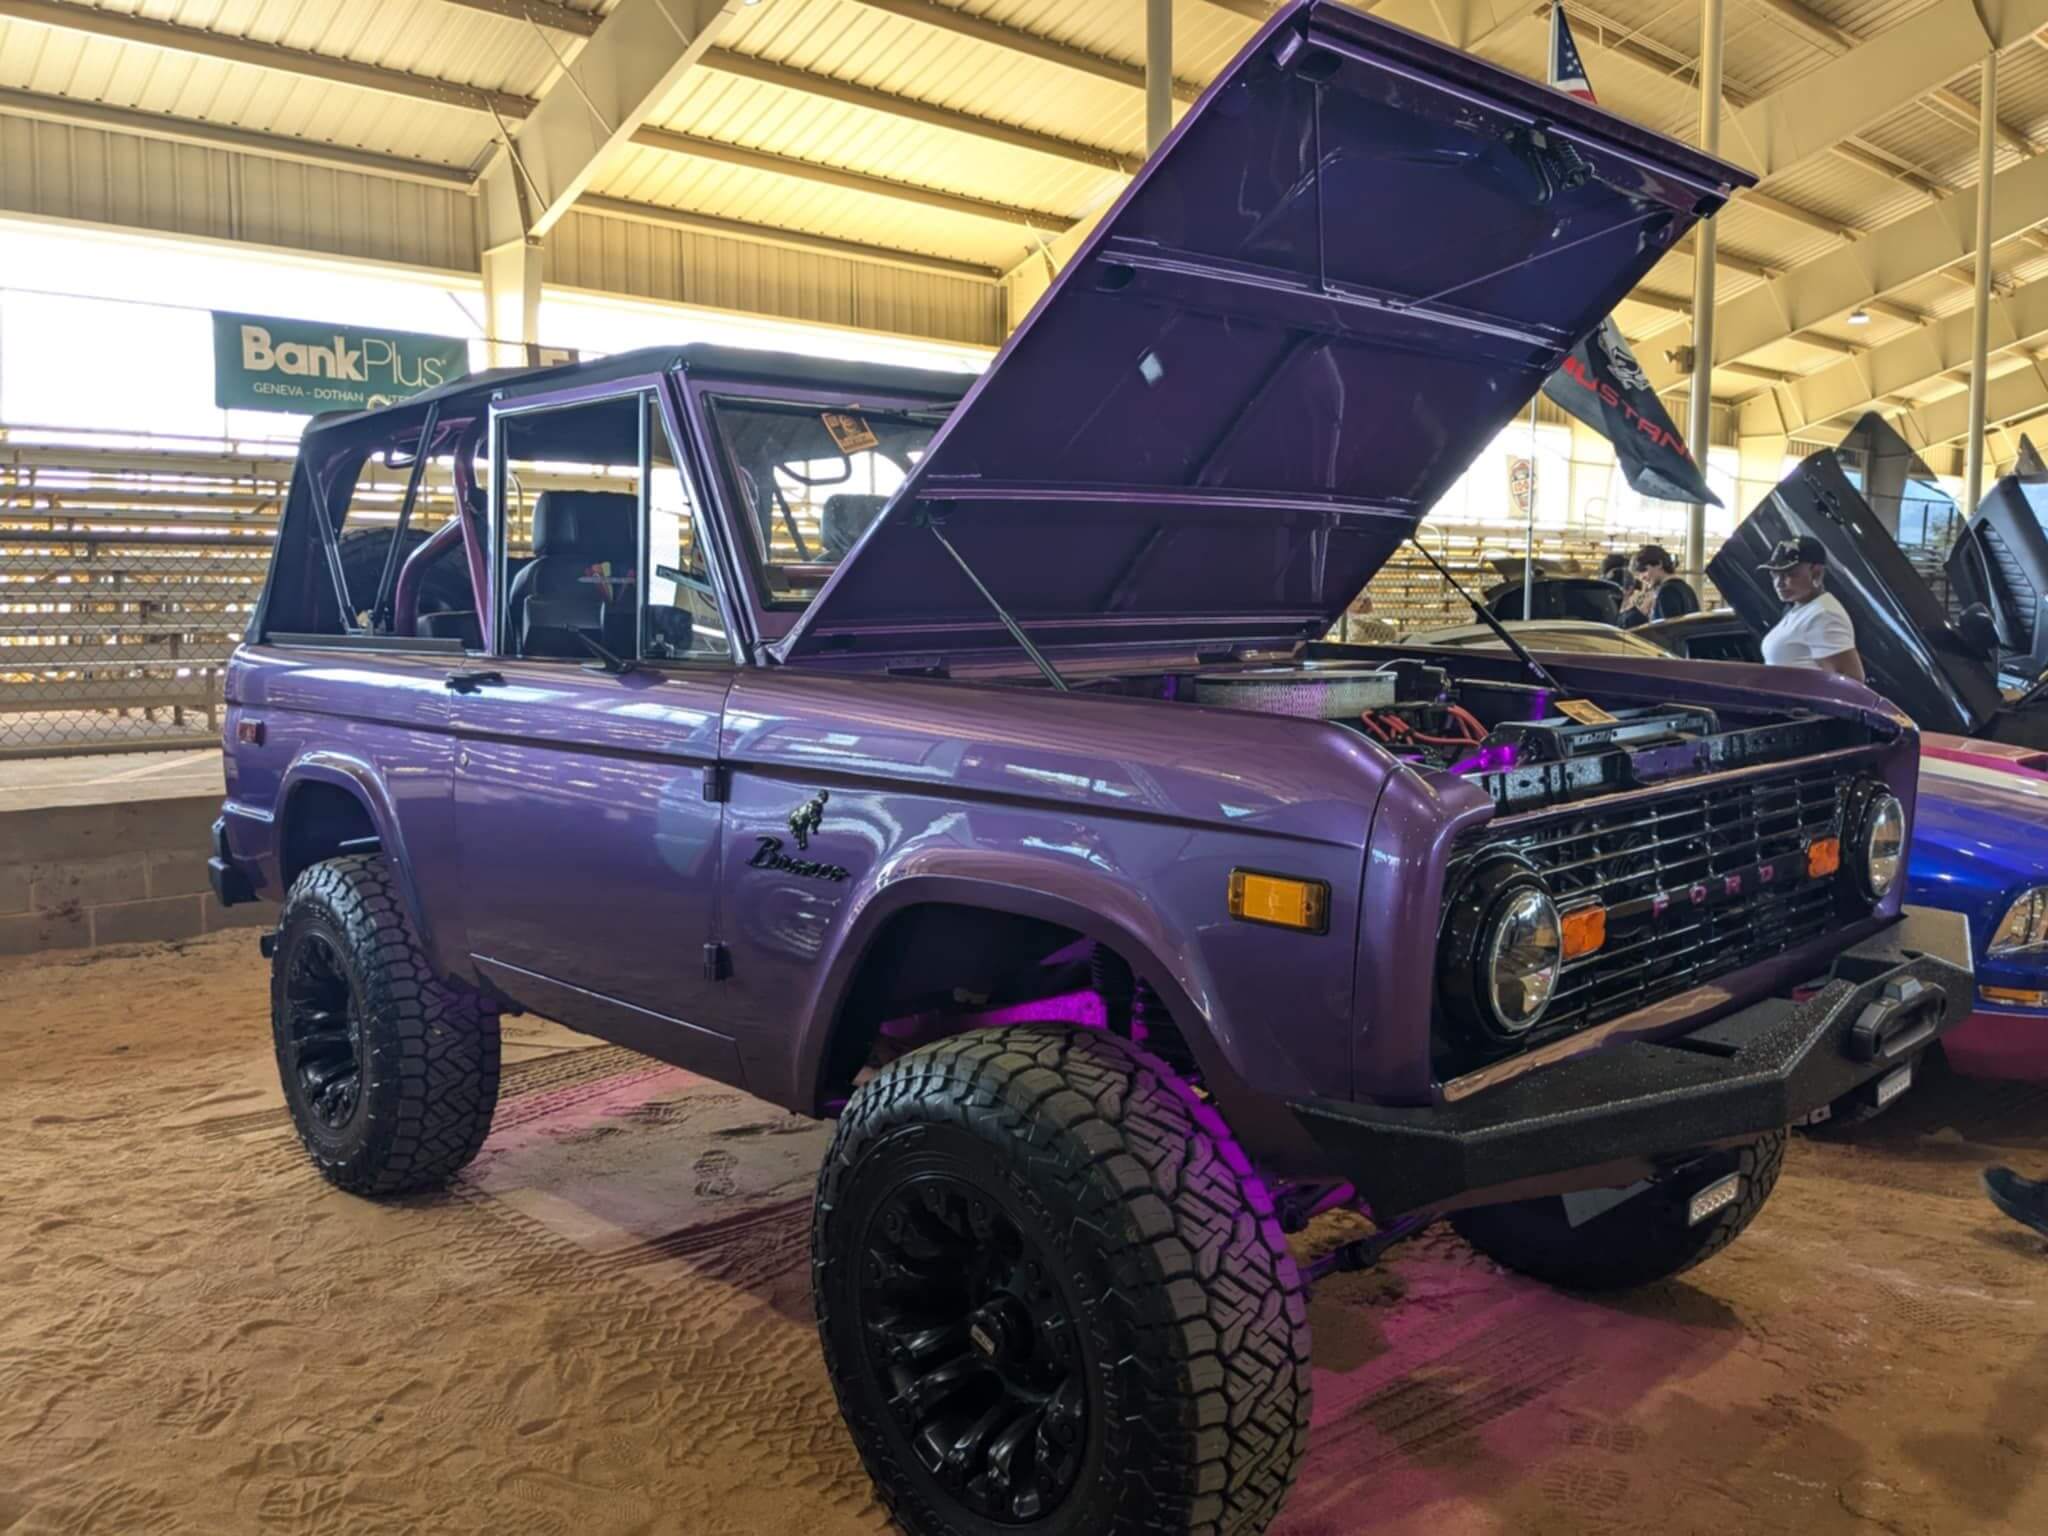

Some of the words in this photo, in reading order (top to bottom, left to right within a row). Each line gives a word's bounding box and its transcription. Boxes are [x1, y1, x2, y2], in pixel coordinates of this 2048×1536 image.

[240, 325, 444, 388] BankPlus
[253, 381, 304, 397] GENEVA
[313, 388, 363, 402] DOTHAN
[1561, 355, 1696, 464] USTAN
[1653, 864, 1774, 917] FORD
